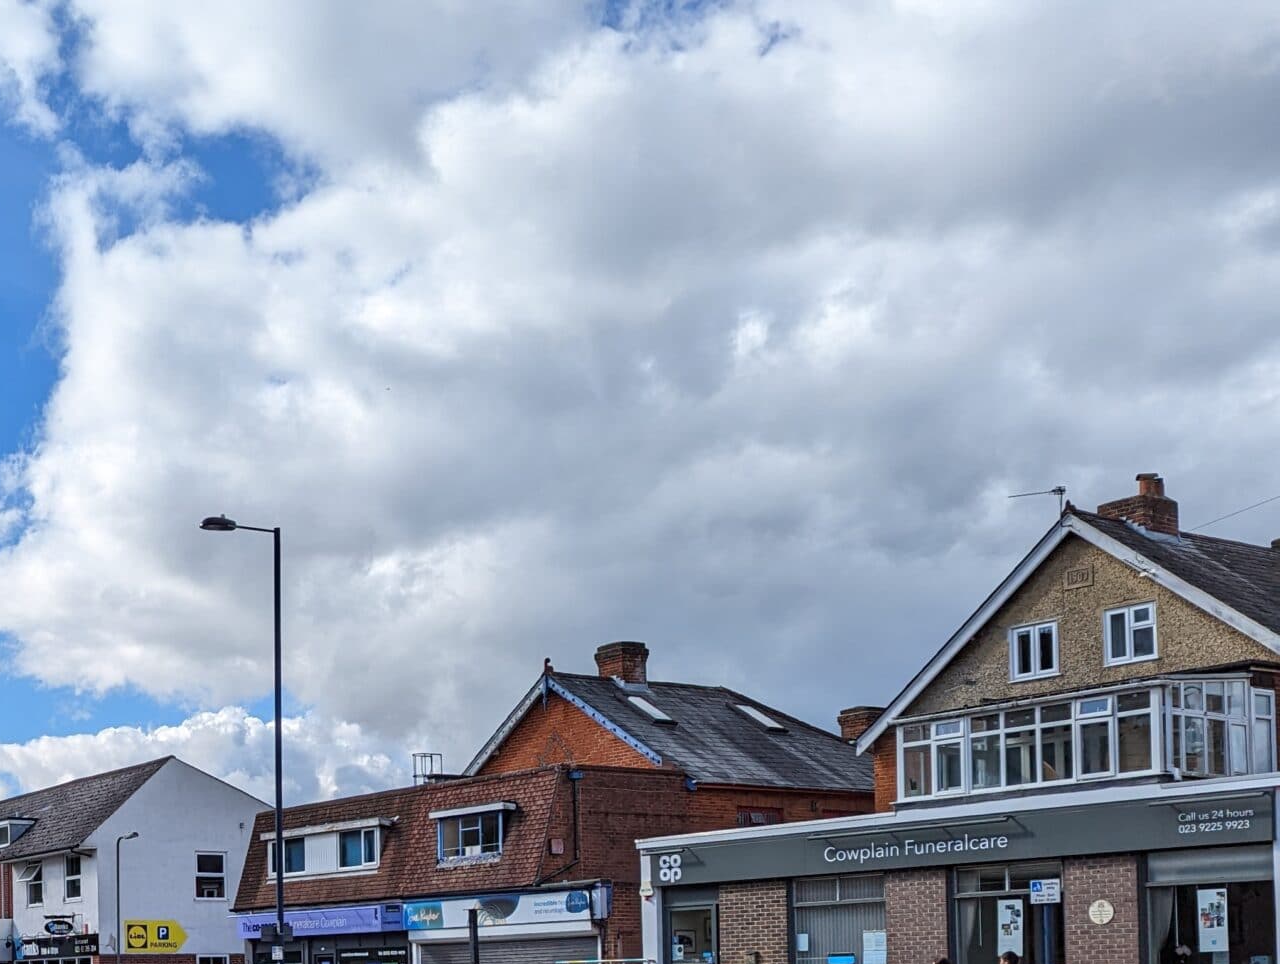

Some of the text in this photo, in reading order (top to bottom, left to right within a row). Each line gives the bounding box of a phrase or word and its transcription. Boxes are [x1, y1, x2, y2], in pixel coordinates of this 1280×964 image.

[1178, 812, 1196, 822] Call
[1211, 810, 1224, 819] 24
[1226, 808, 1255, 818] hours
[1178, 819, 1250, 834] 023 9225 9923
[824, 833, 1008, 864] Cowplain Funeralcare
[242, 922, 252, 933] The
[320, 917, 347, 930] Cowplain
[159, 927, 167, 939] P
